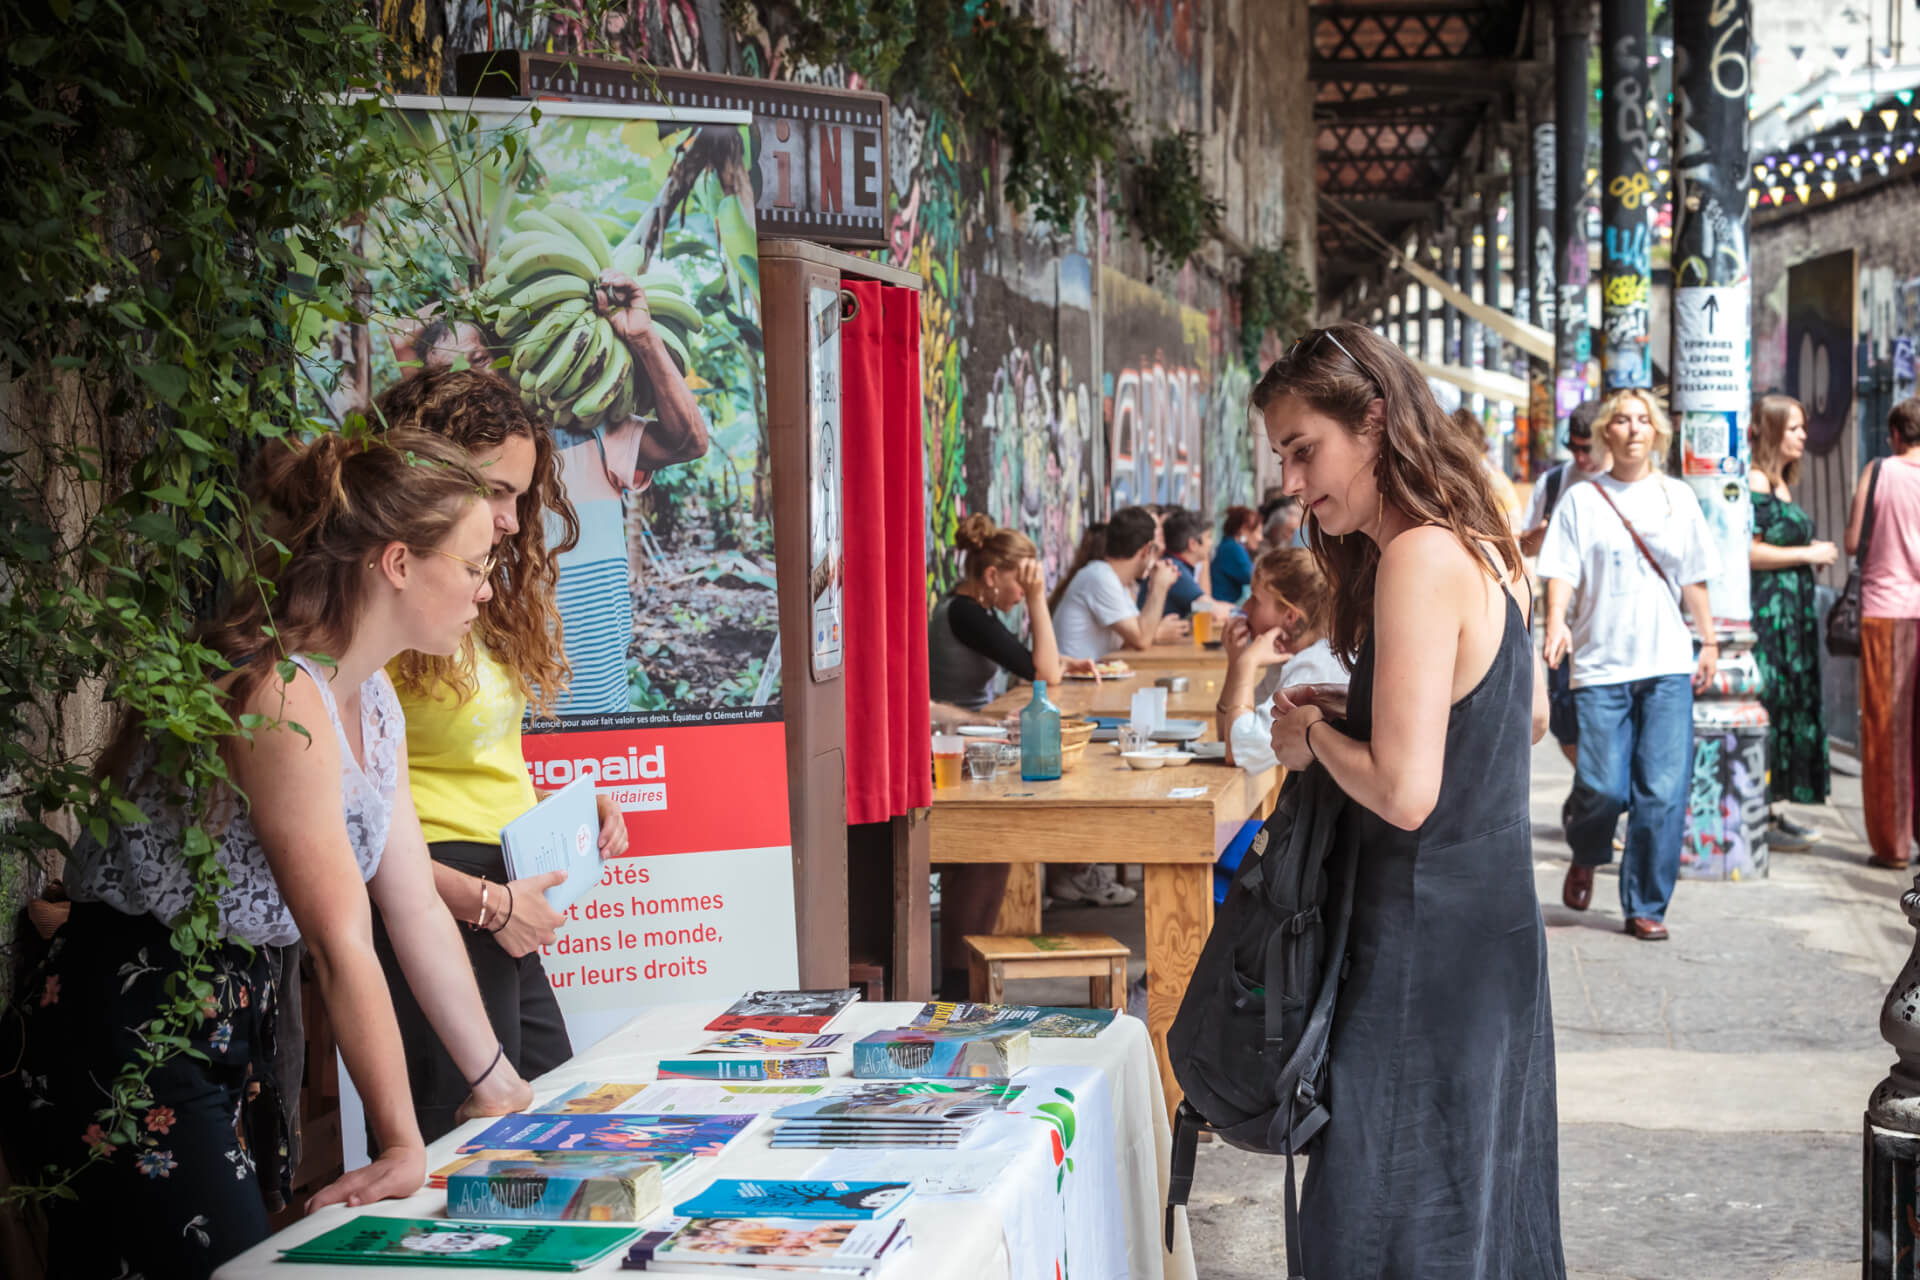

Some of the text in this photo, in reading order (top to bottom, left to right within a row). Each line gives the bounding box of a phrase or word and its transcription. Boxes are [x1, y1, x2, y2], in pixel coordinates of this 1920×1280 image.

[562, 719, 580, 729] pour
[581, 718, 599, 727] avoir
[600, 716, 613, 725] fait
[614, 715, 635, 725] valoir
[637, 715, 648, 724] ses
[649, 713, 671, 723] droits.
[672, 710, 703, 722] Équateur
[713, 709, 743, 720] Clément
[744, 709, 763, 719] Lefer
[611, 790, 663, 803] lidaires
[585, 900, 625, 920] des
[631, 894, 724, 916] hommes
[556, 934, 612, 955] dans
[618, 930, 637, 950] le
[644, 923, 723, 947] monde,
[581, 965, 638, 986] leurs
[644, 956, 708, 980] droits
[864, 1047, 933, 1074] AGRONAUTES
[462, 1181, 545, 1215] AGRONAUTES
